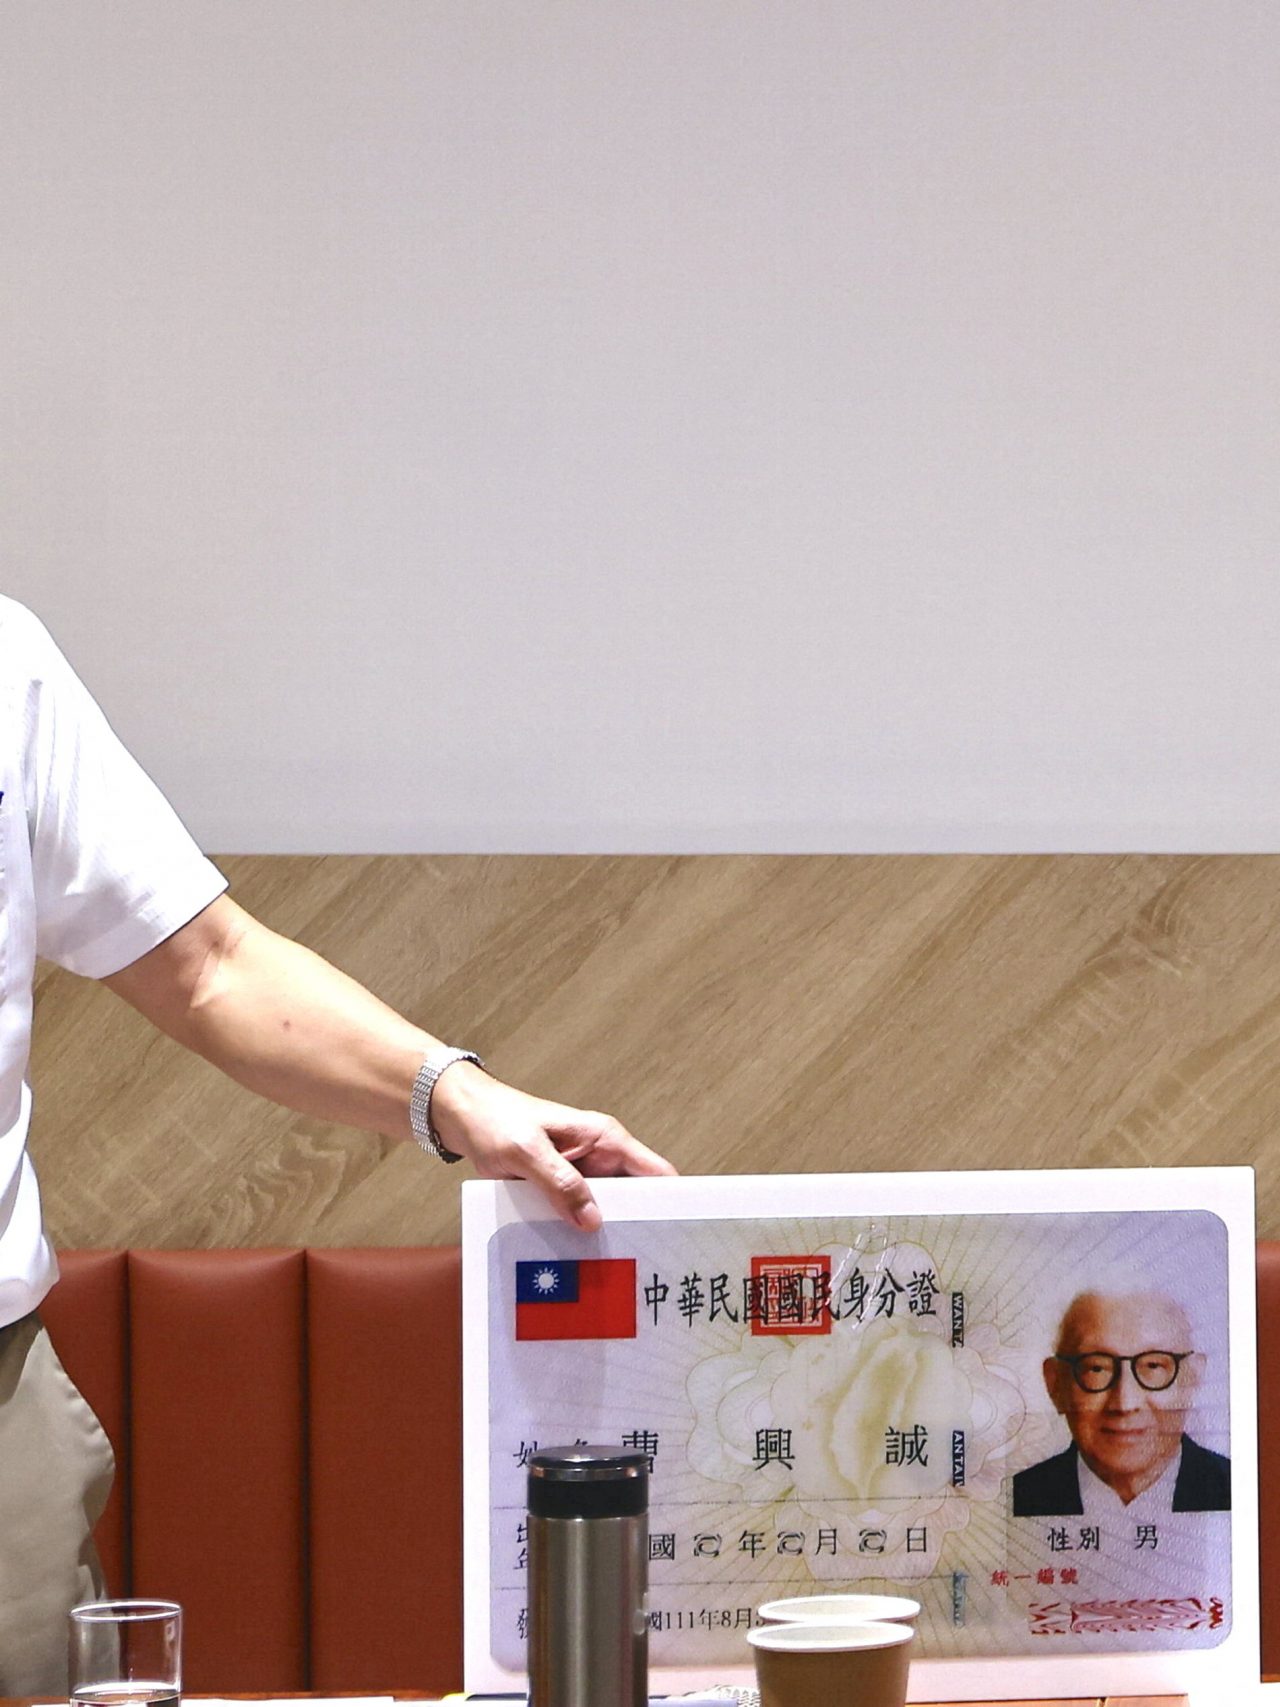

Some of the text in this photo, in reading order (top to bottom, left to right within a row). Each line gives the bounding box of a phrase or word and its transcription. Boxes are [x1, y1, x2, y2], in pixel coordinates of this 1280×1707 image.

[644, 1267, 940, 1328] 中華民國國民身分證
[752, 1428, 795, 1471] 興
[885, 1424, 929, 1467] 誠
[1047, 1525, 1158, 1551] 性別 男
